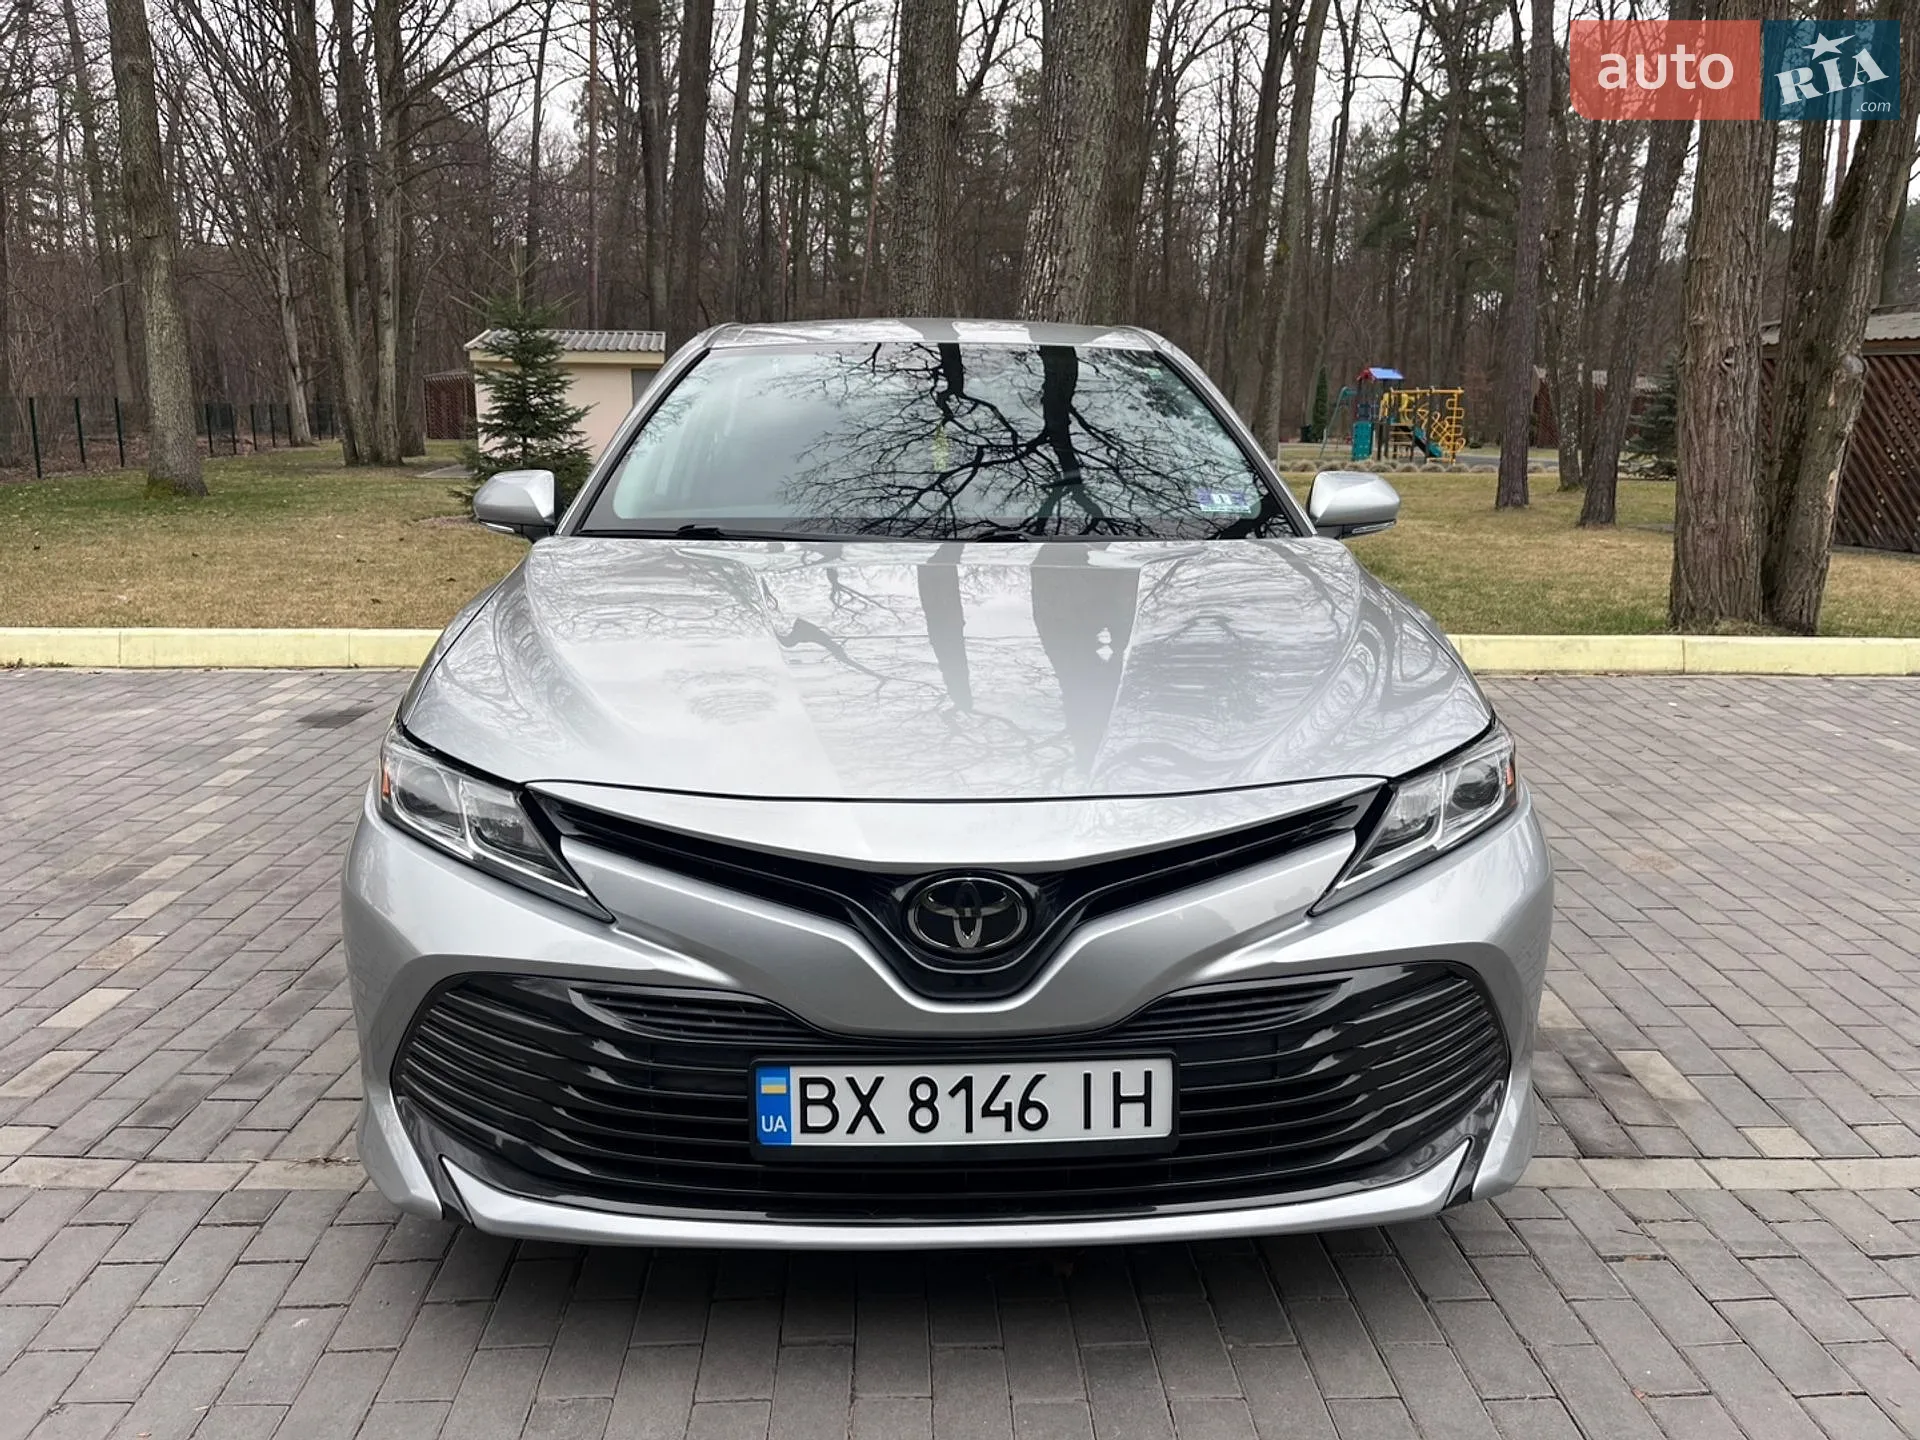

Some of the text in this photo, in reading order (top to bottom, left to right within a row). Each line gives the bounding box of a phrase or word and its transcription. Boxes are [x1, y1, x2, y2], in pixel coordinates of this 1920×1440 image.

[799, 1070, 1153, 1135] BX 8146 IH
[761, 1115, 787, 1133] UA
